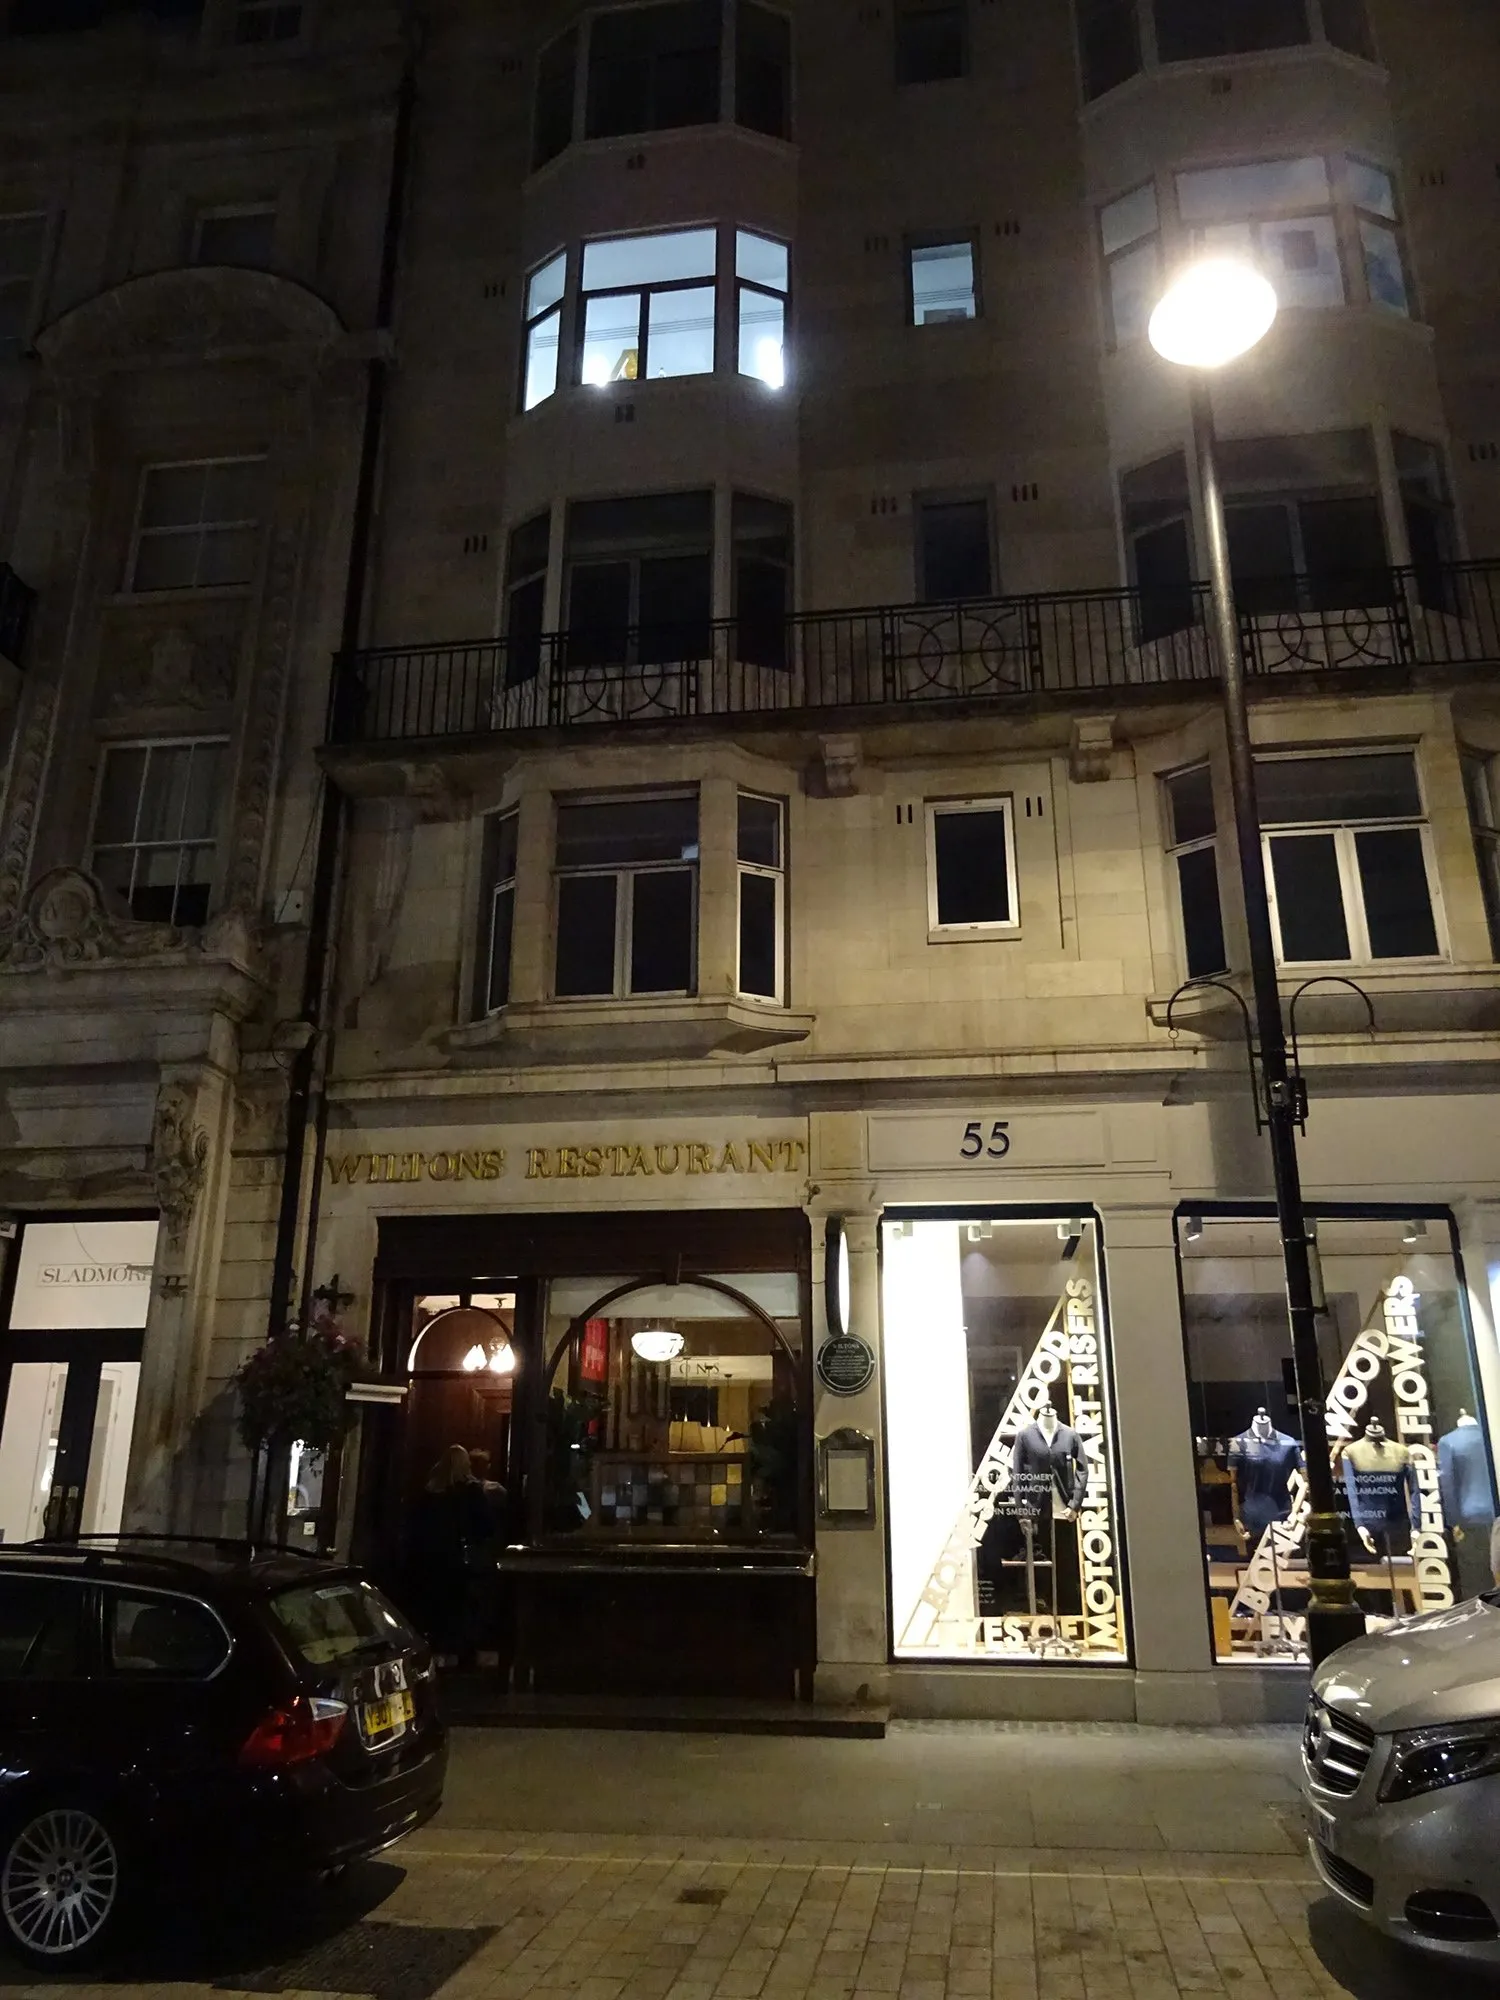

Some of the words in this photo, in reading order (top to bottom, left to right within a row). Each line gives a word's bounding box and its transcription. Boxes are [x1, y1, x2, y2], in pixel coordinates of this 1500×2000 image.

[326, 1148, 505, 1186] WILTONS
[525, 1138, 808, 1181] RESTAURANT
[960, 1121, 1012, 1158] 55
[1003, 1330, 1070, 1436] WOOD
[1066, 1277, 1099, 1386] RISERS
[1324, 1328, 1390, 1439] WOOD
[1383, 1275, 1434, 1435] FLOWERS
[1006, 1507, 1042, 1516] SMEDLEY
[1072, 1394, 1118, 1649] MOTORHEART
